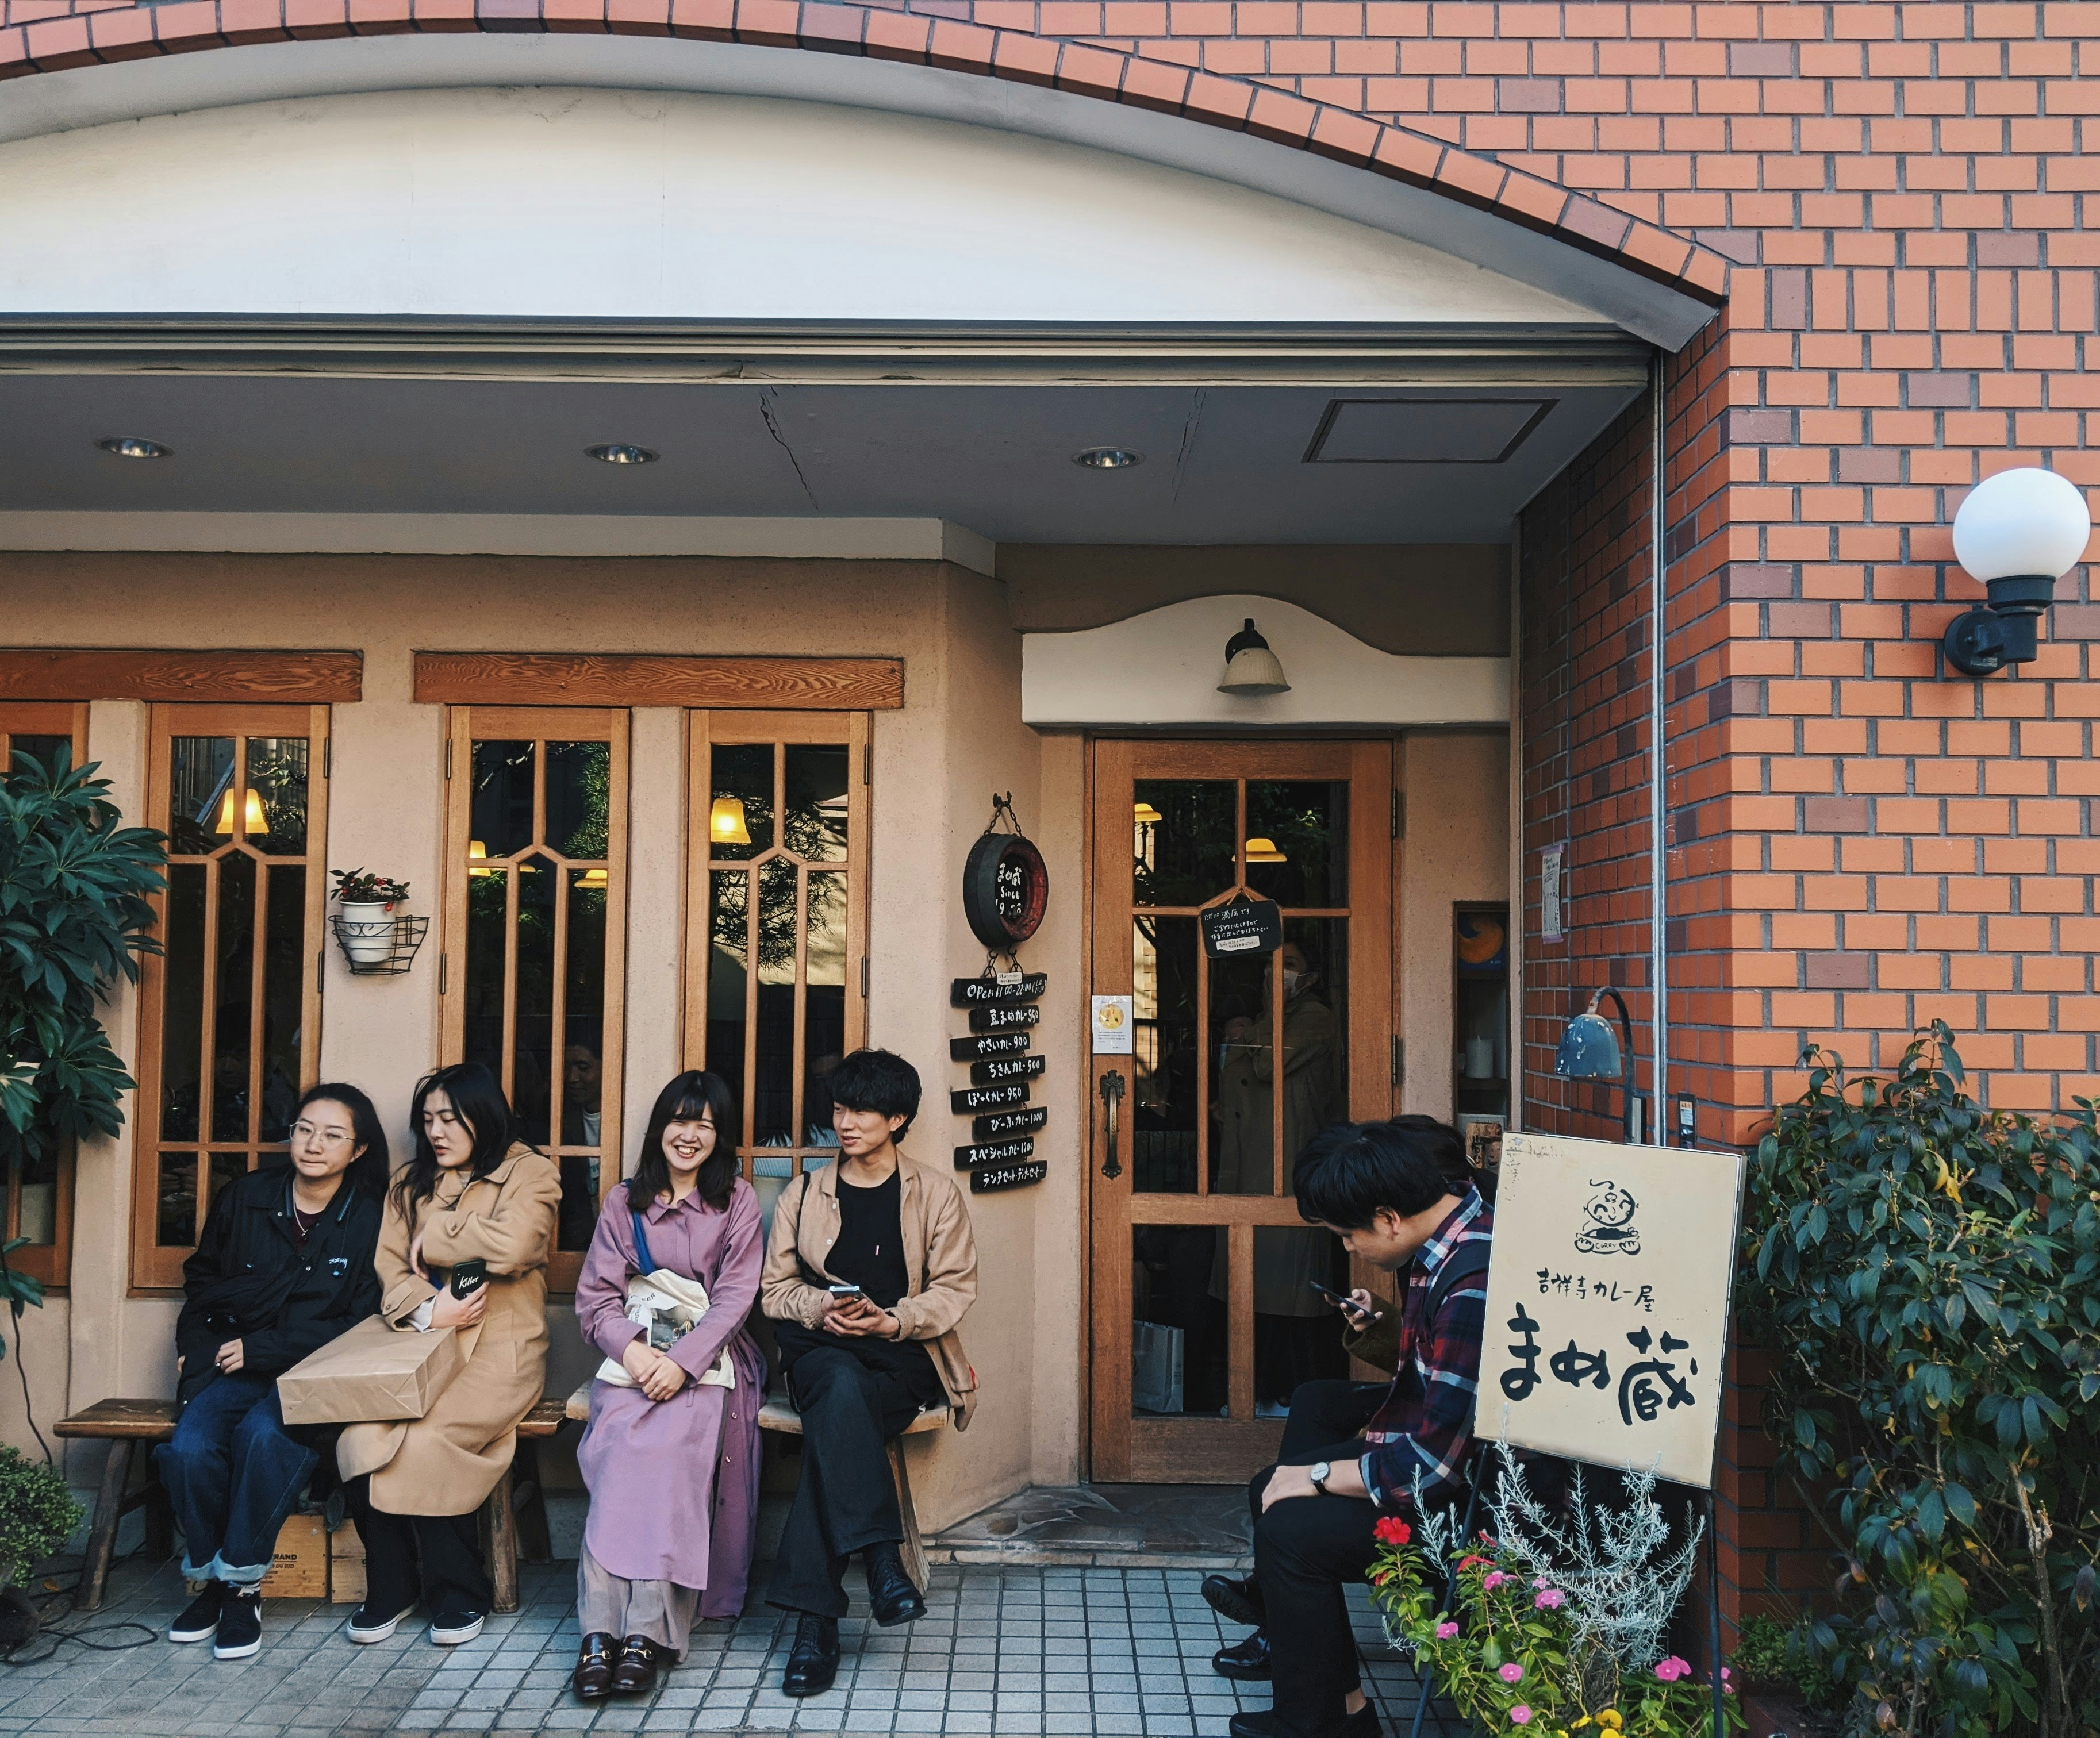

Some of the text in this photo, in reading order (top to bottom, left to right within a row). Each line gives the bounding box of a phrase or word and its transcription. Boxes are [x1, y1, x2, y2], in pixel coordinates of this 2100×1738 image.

[997, 862, 1022, 886] まめ蔵
[1001, 886, 1020, 899] Since
[1028, 1009, 1039, 1023] 950
[978, 1036, 1027, 1053] やさいカレー 900
[989, 1060, 1040, 1078] ちきんカレー 900
[1007, 1087, 1022, 1101] 950
[1030, 1112, 1042, 1124] 1000
[969, 1142, 1033, 1163] スペシャルカレー 1200
[459, 1276, 479, 1289] Killer
[1537, 1267, 1655, 1312] 吉祥寺カレー屋
[1500, 1302, 1698, 1426] まめ蔵
